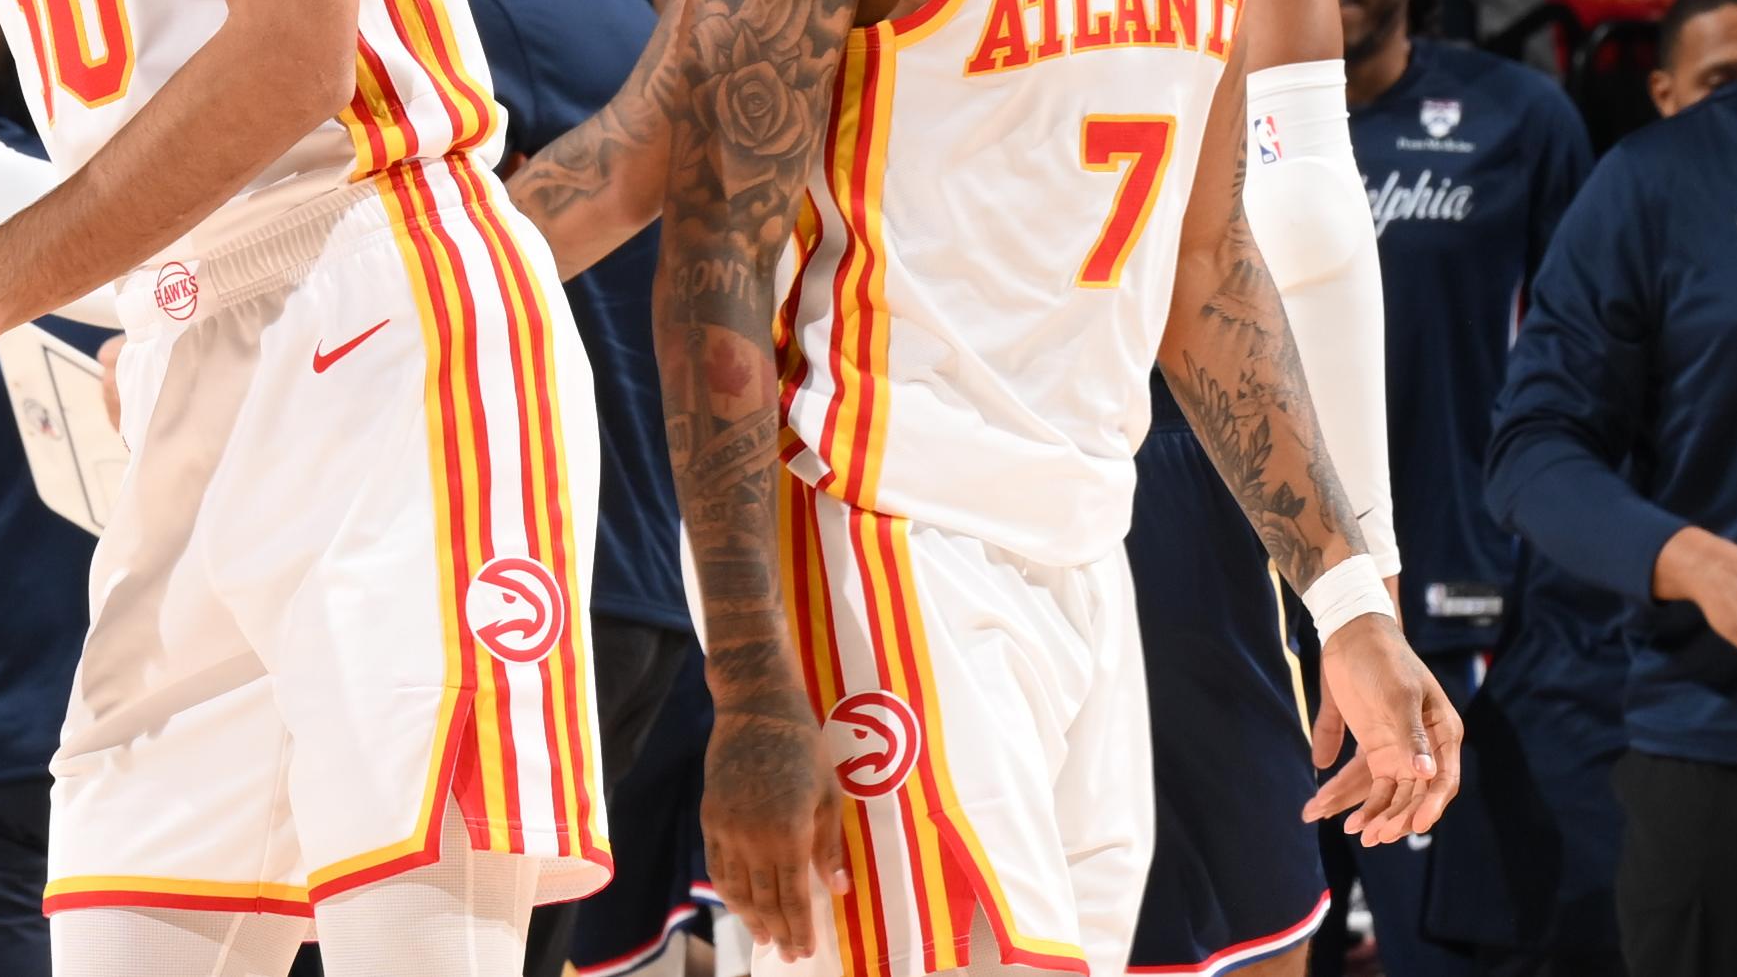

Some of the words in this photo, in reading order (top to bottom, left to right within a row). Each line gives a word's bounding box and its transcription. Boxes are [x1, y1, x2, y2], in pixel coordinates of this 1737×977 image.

[1075, 113, 1177, 289] 7
[1364, 169, 1473, 240] elphia
[154, 275, 199, 308] HAWKS
